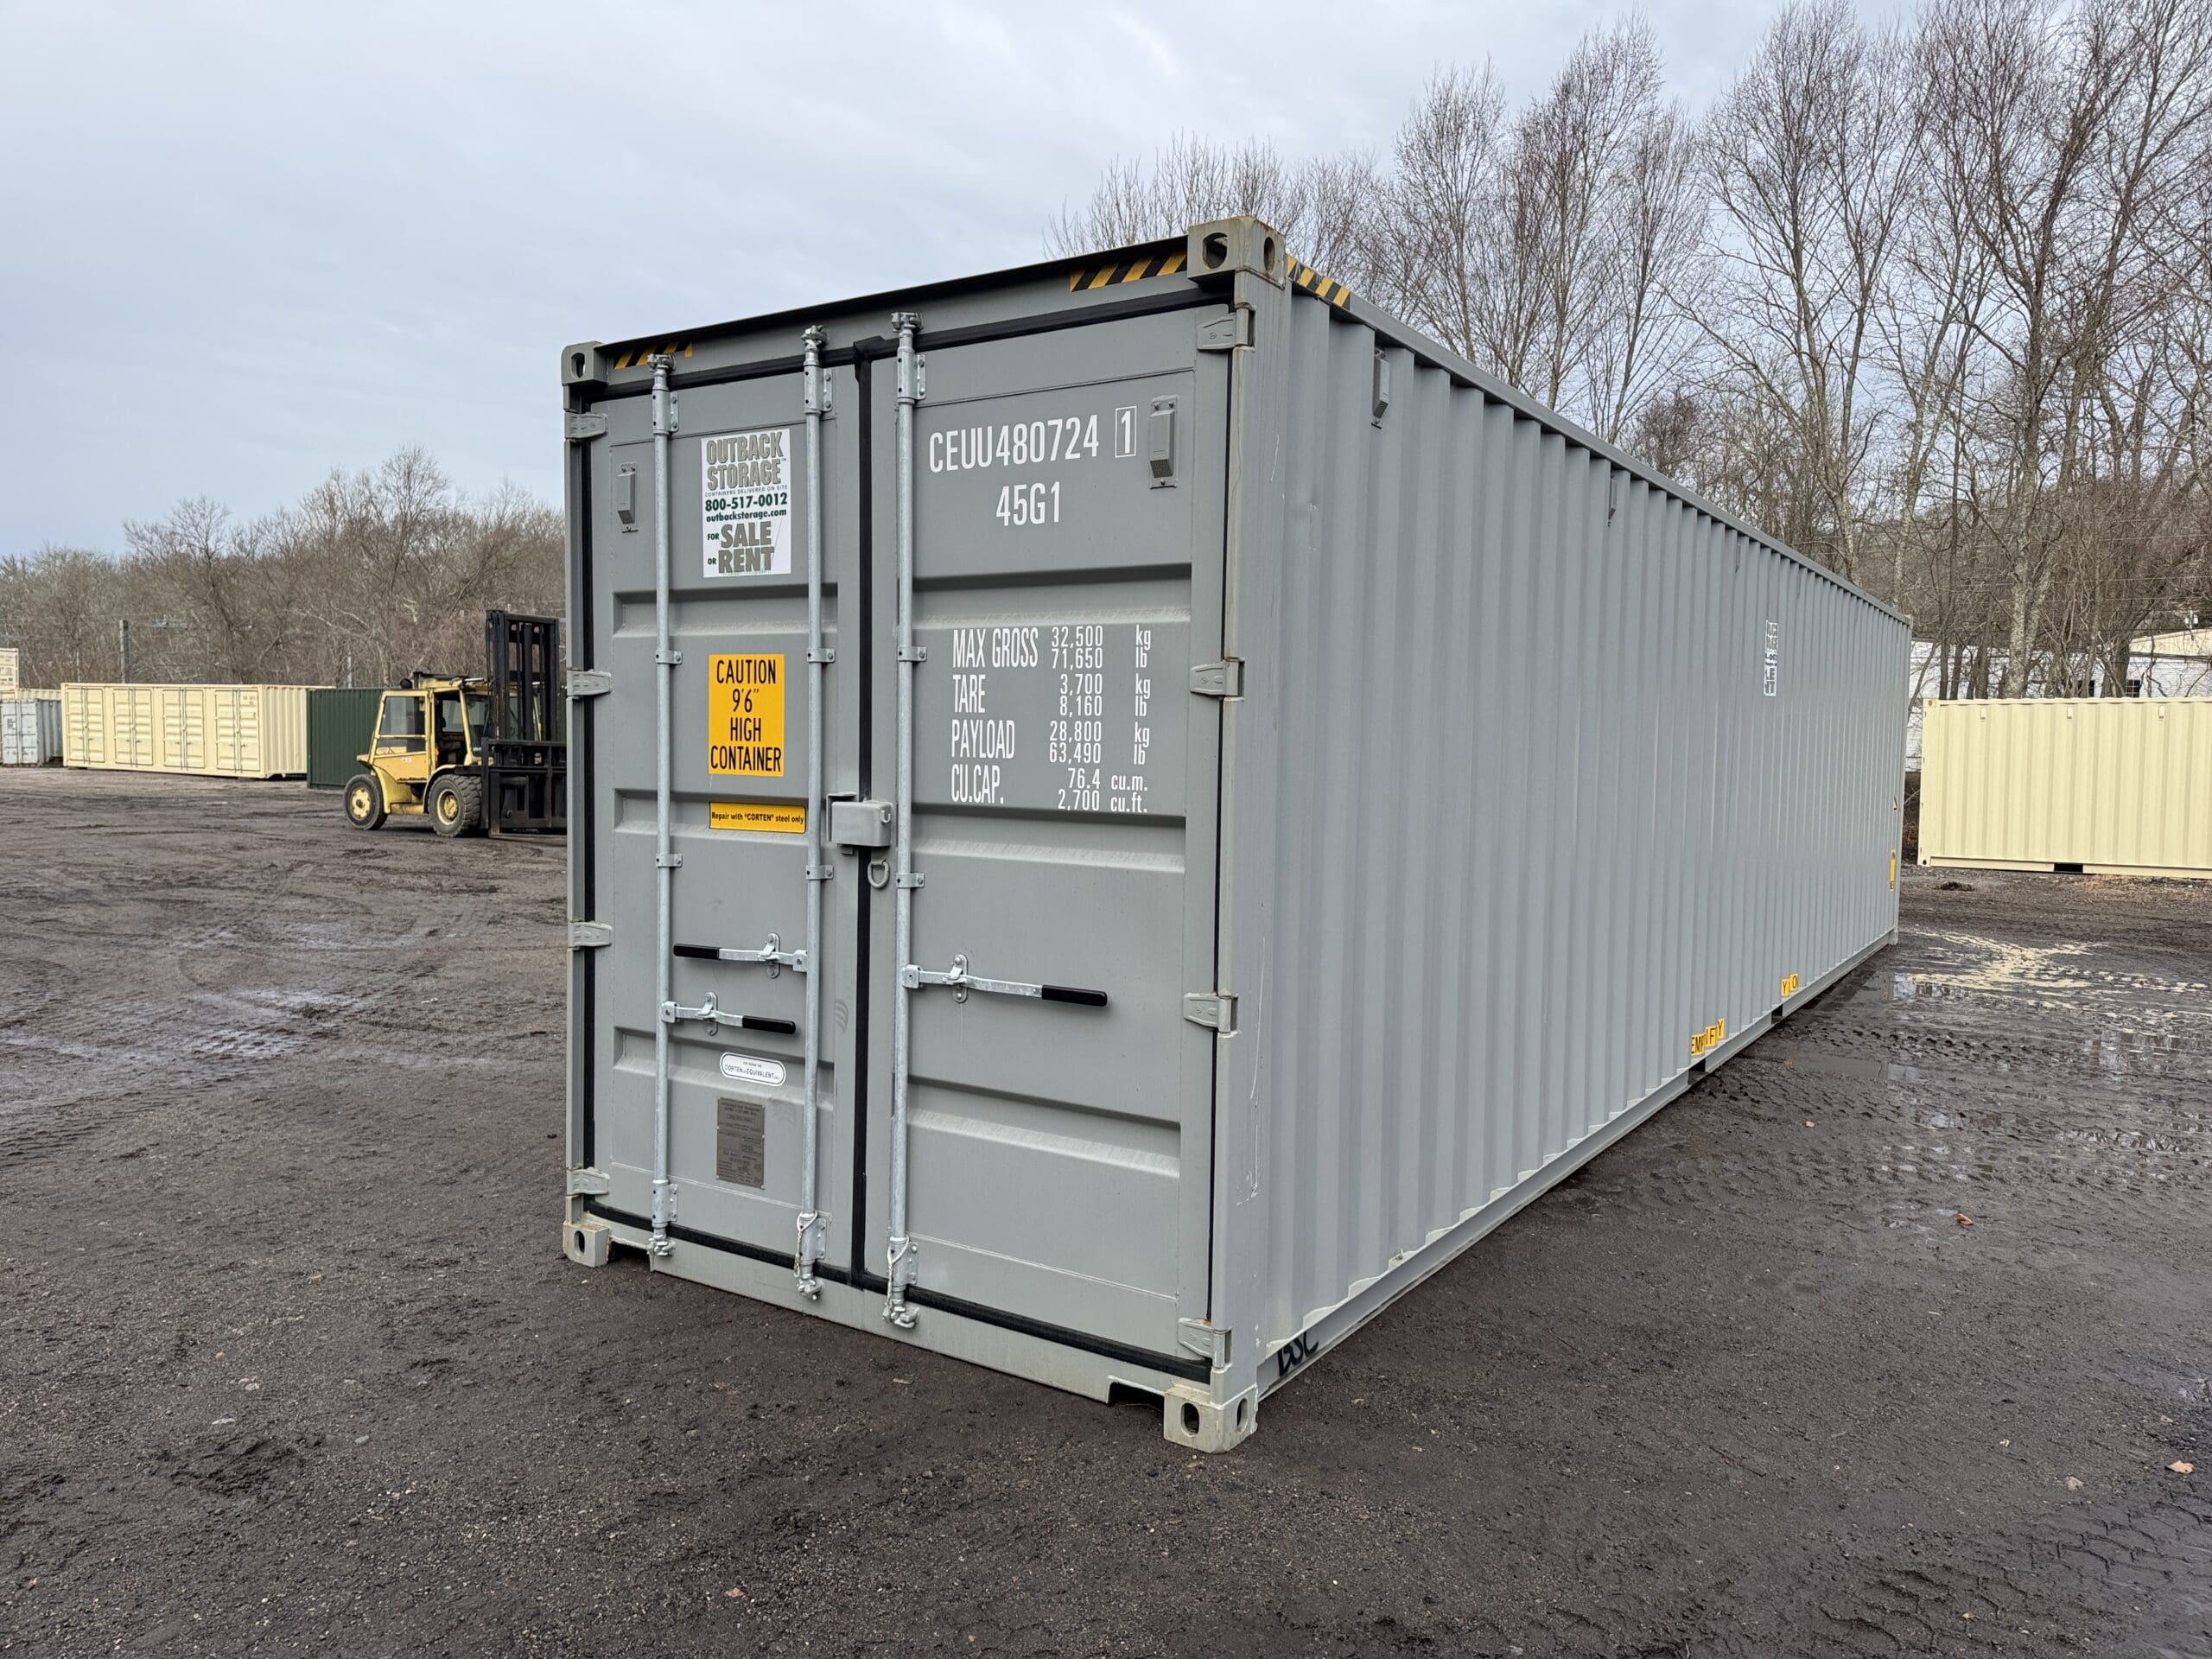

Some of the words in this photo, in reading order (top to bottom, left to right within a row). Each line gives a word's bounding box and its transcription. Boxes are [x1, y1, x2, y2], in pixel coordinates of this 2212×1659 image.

[706, 431, 784, 465] OUTBACK
[929, 414, 1099, 473] CEUU480724
[1121, 410, 1131, 454] 1
[707, 458, 781, 491] STORAGE
[705, 492, 788, 512] 800-517-0012
[706, 509, 786, 522] outbackstorage.com
[996, 481, 1060, 526] 45G1
[721, 520, 772, 549] SALE
[718, 546, 774, 574] RENT
[952, 629, 986, 668] MAX
[992, 627, 1039, 668] GROSS
[1051, 626, 1103, 648] 32,500
[1135, 624, 1151, 650] kg
[1051, 647, 1103, 670] 71,650
[1135, 647, 1147, 668] lb
[716, 659, 776, 684] CAUTION
[952, 674, 986, 713] TARE
[1059, 673, 1103, 696] 3,700
[1135, 673, 1151, 699] kg
[1059, 695, 1103, 717] 8,160
[1135, 696, 1147, 716] lb
[730, 717, 761, 742] HIGH
[951, 719, 1015, 759] PAYLOAD
[1050, 721, 1102, 743] 28,800
[1134, 721, 1150, 747] kg
[710, 745, 782, 772] CONTAINER
[1049, 742, 1101, 764] 63,490
[1134, 743, 1146, 765] lb
[951, 764, 1004, 804] CU.CAP.
[1068, 767, 1101, 790] 76.4
[1111, 775, 1147, 791] cu.m.
[1058, 789, 1100, 810] 2,700
[1110, 792, 1147, 813] cu.ft.
[711, 812, 729, 821] Repair
[791, 816, 804, 824] only
[725, 1064, 742, 1073] CORTEN
[747, 1068, 775, 1079] EQUIVALENT
